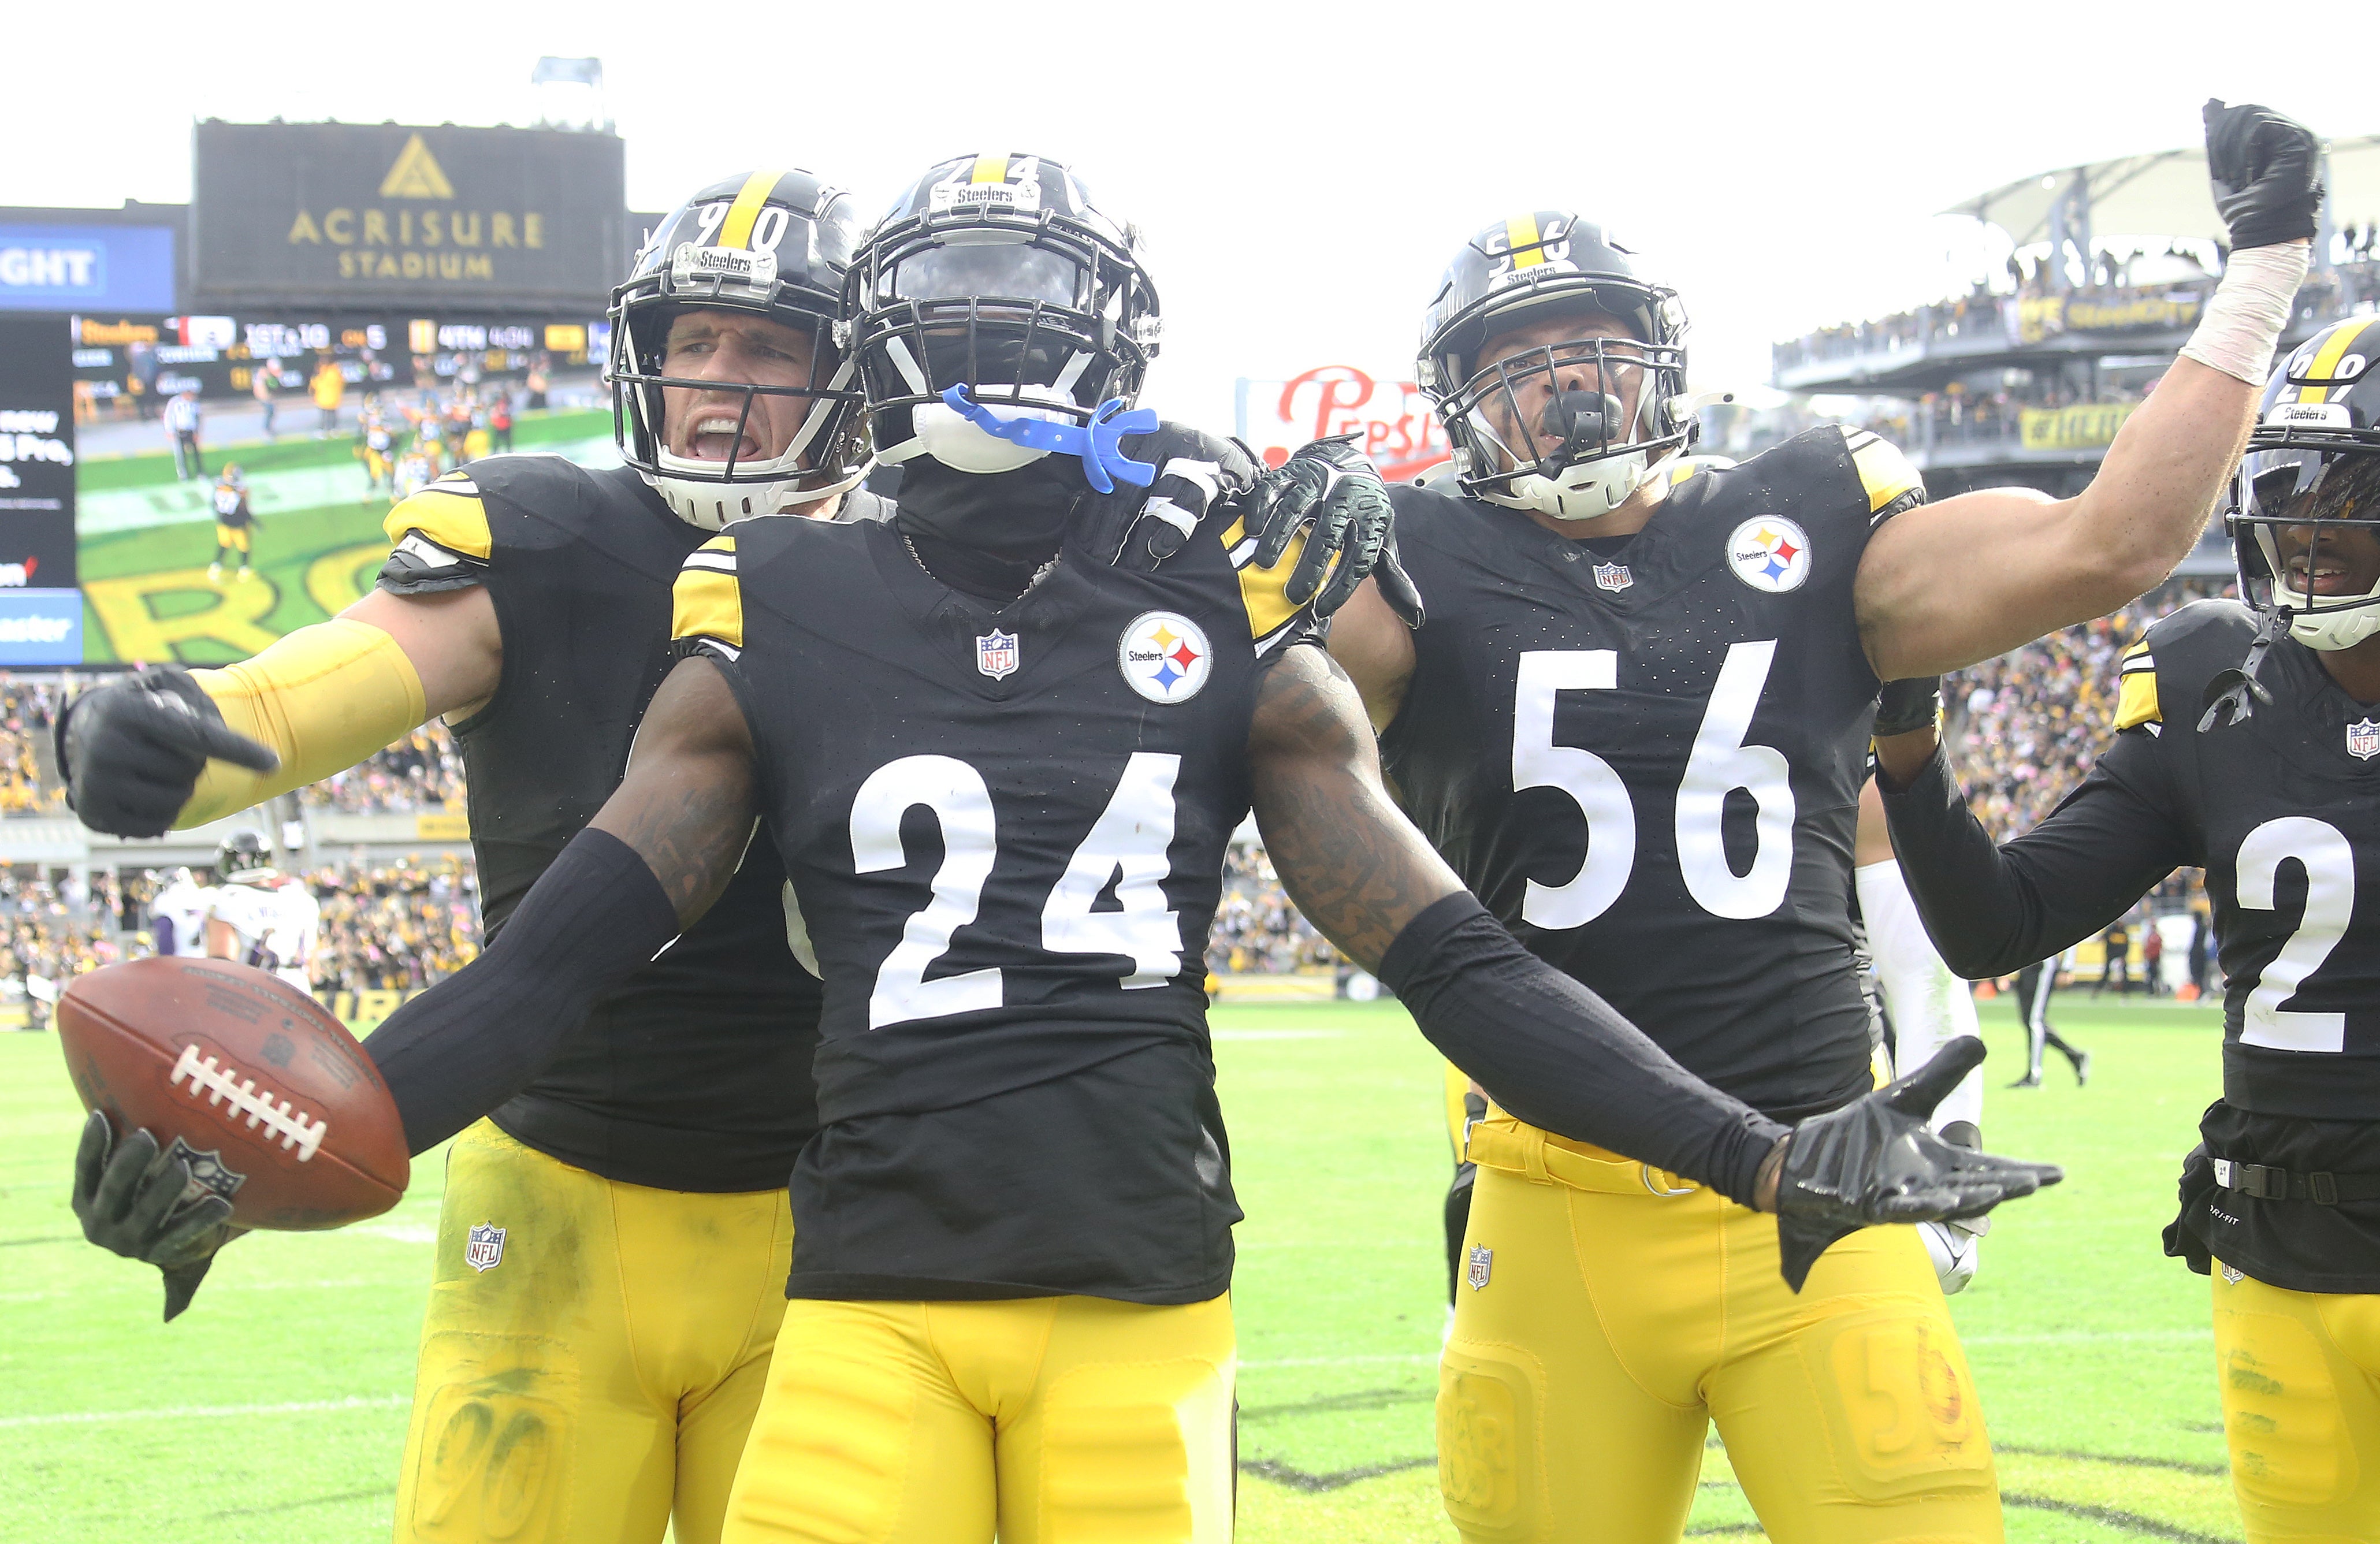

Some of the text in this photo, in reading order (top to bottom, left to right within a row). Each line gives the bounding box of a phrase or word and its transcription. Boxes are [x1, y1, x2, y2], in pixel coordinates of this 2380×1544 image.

[958, 185, 1013, 204] Steelers
[288, 207, 544, 249] ACRISURE
[693, 202, 790, 252] 90
[339, 250, 494, 281] STADIUM
[700, 251, 750, 273] Steelers
[1507, 265, 1556, 285] Steelers
[2285, 406, 2327, 421] Steelers
[1736, 550, 1768, 562] Steelers
[1600, 574, 1627, 586] NFL
[984, 651, 1013, 670] NFL
[1128, 651, 1163, 661] Steelers
[2353, 736, 2377, 752] NFL
[1511, 638, 1796, 931] 56
[849, 751, 1185, 1031] 24
[2236, 816, 2356, 1053] 2
[471, 1243, 495, 1263] NFL
[1470, 1263, 1485, 1281] NFL
